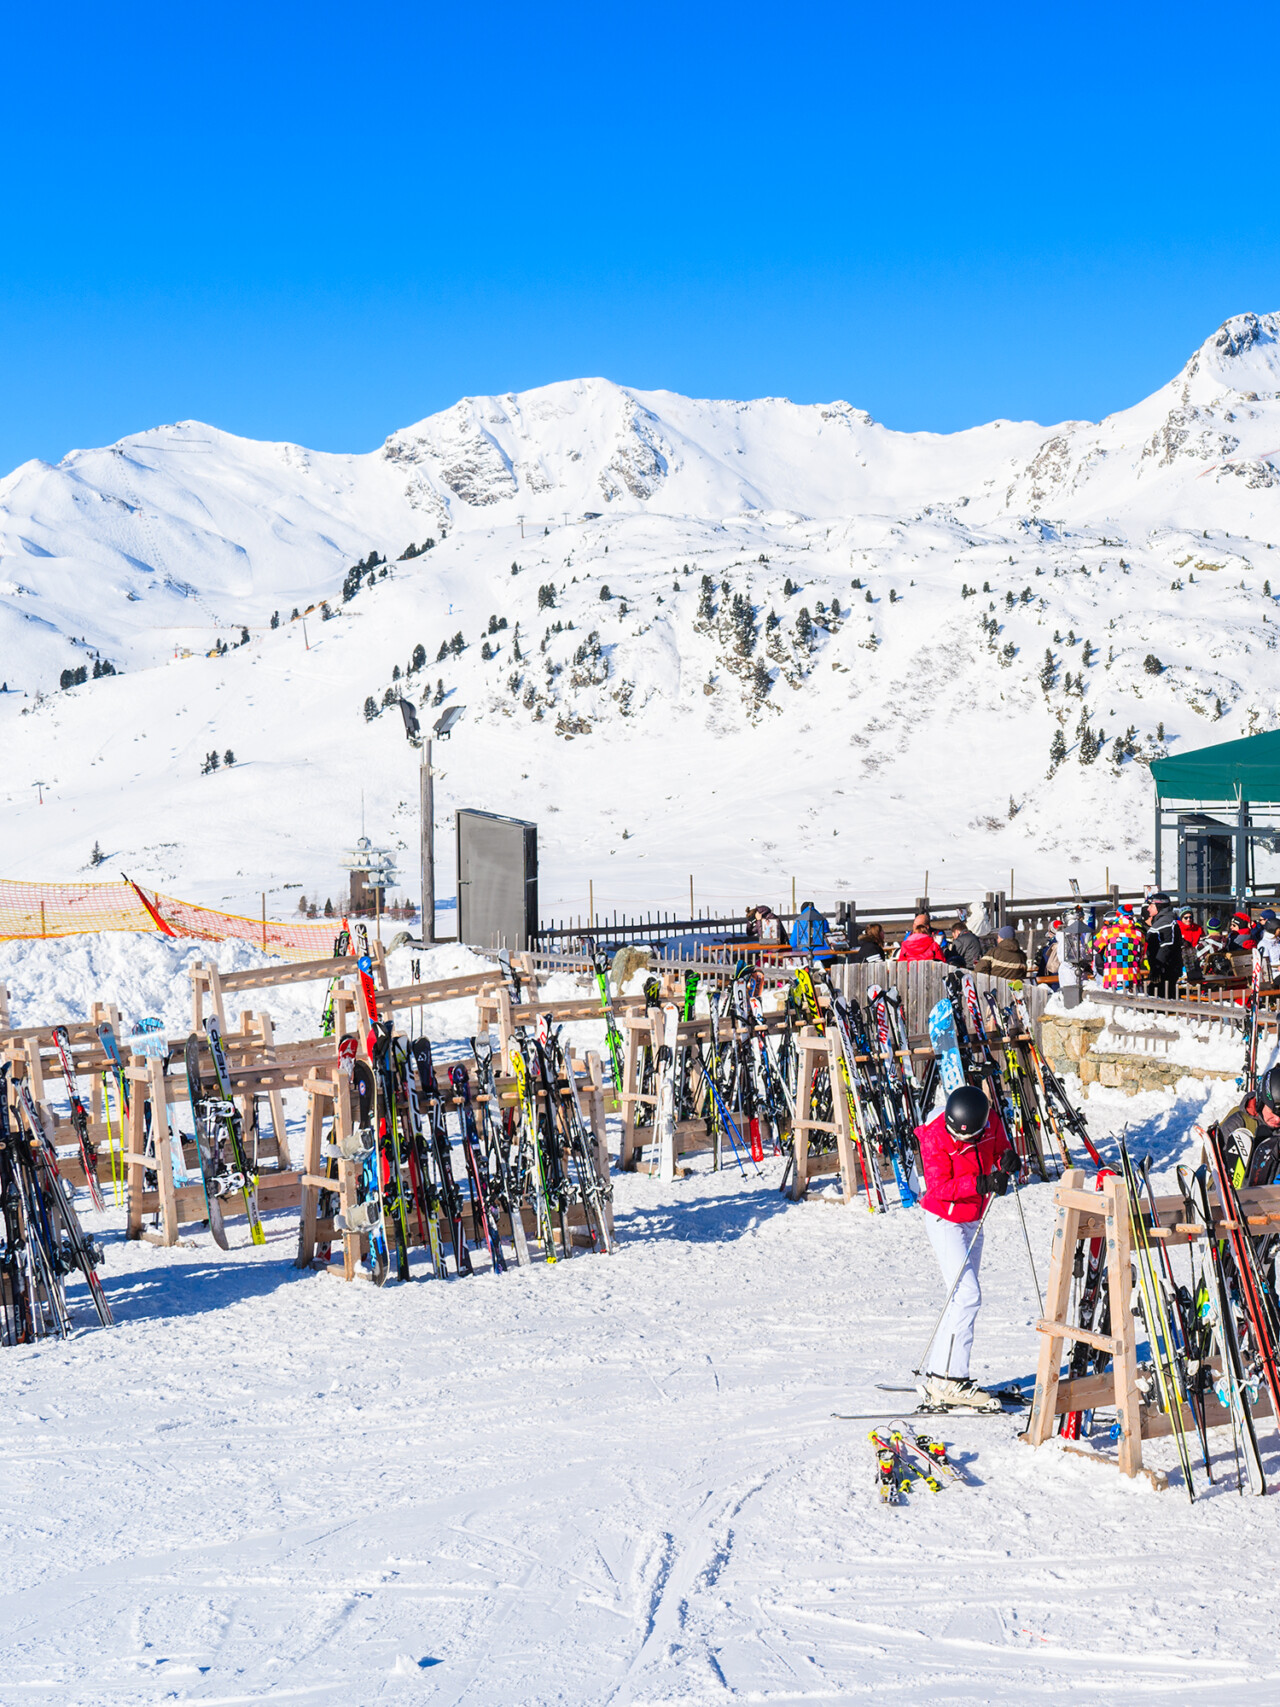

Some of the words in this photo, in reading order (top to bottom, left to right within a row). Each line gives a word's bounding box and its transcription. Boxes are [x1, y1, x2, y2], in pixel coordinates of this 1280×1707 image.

[365, 977, 376, 1018] BLIZZARD
[210, 1028, 228, 1080] HEAD
[839, 1024, 859, 1081] FISCHER
[1, 1094, 10, 1136] HEAD
[1235, 1133, 1249, 1157] 700
